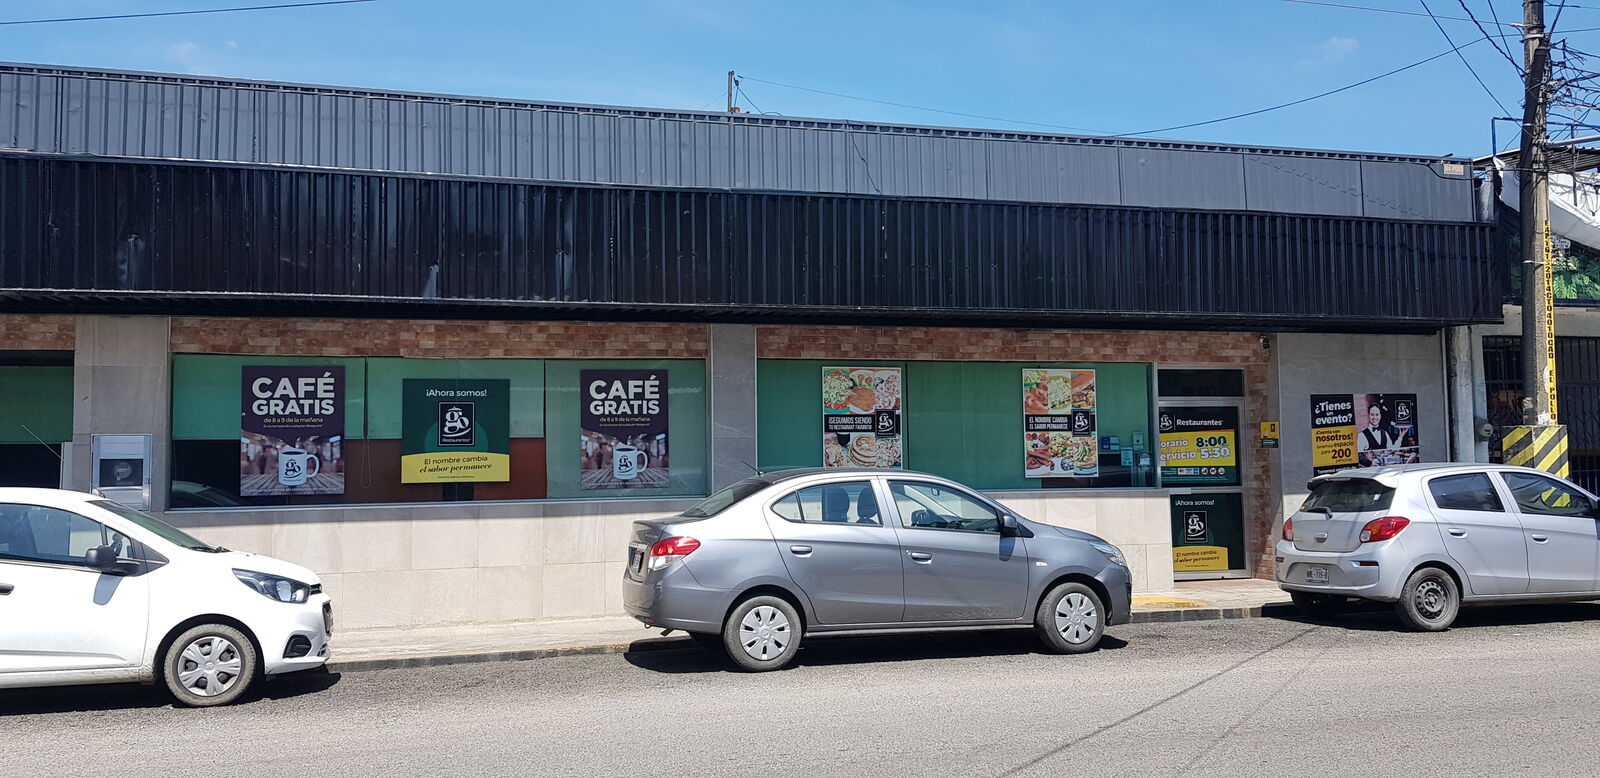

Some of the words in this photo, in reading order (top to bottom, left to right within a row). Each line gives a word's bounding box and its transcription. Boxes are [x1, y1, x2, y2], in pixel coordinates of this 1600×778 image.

[252, 372, 334, 398] CAFÉ
[590, 375, 660, 400] CAFÉ
[252, 400, 334, 415] GRATIS
[590, 400, 660, 415] GRATIS
[1315, 401, 1352, 414] ¿Tienes
[1316, 413, 1353, 425] evento?
[1160, 438, 1188, 447] orario
[1316, 432, 1353, 442] nosotros!
[1160, 450, 1196, 460] ervicio
[1331, 448, 1351, 459] 200
[450, 464, 492, 473] permanece
